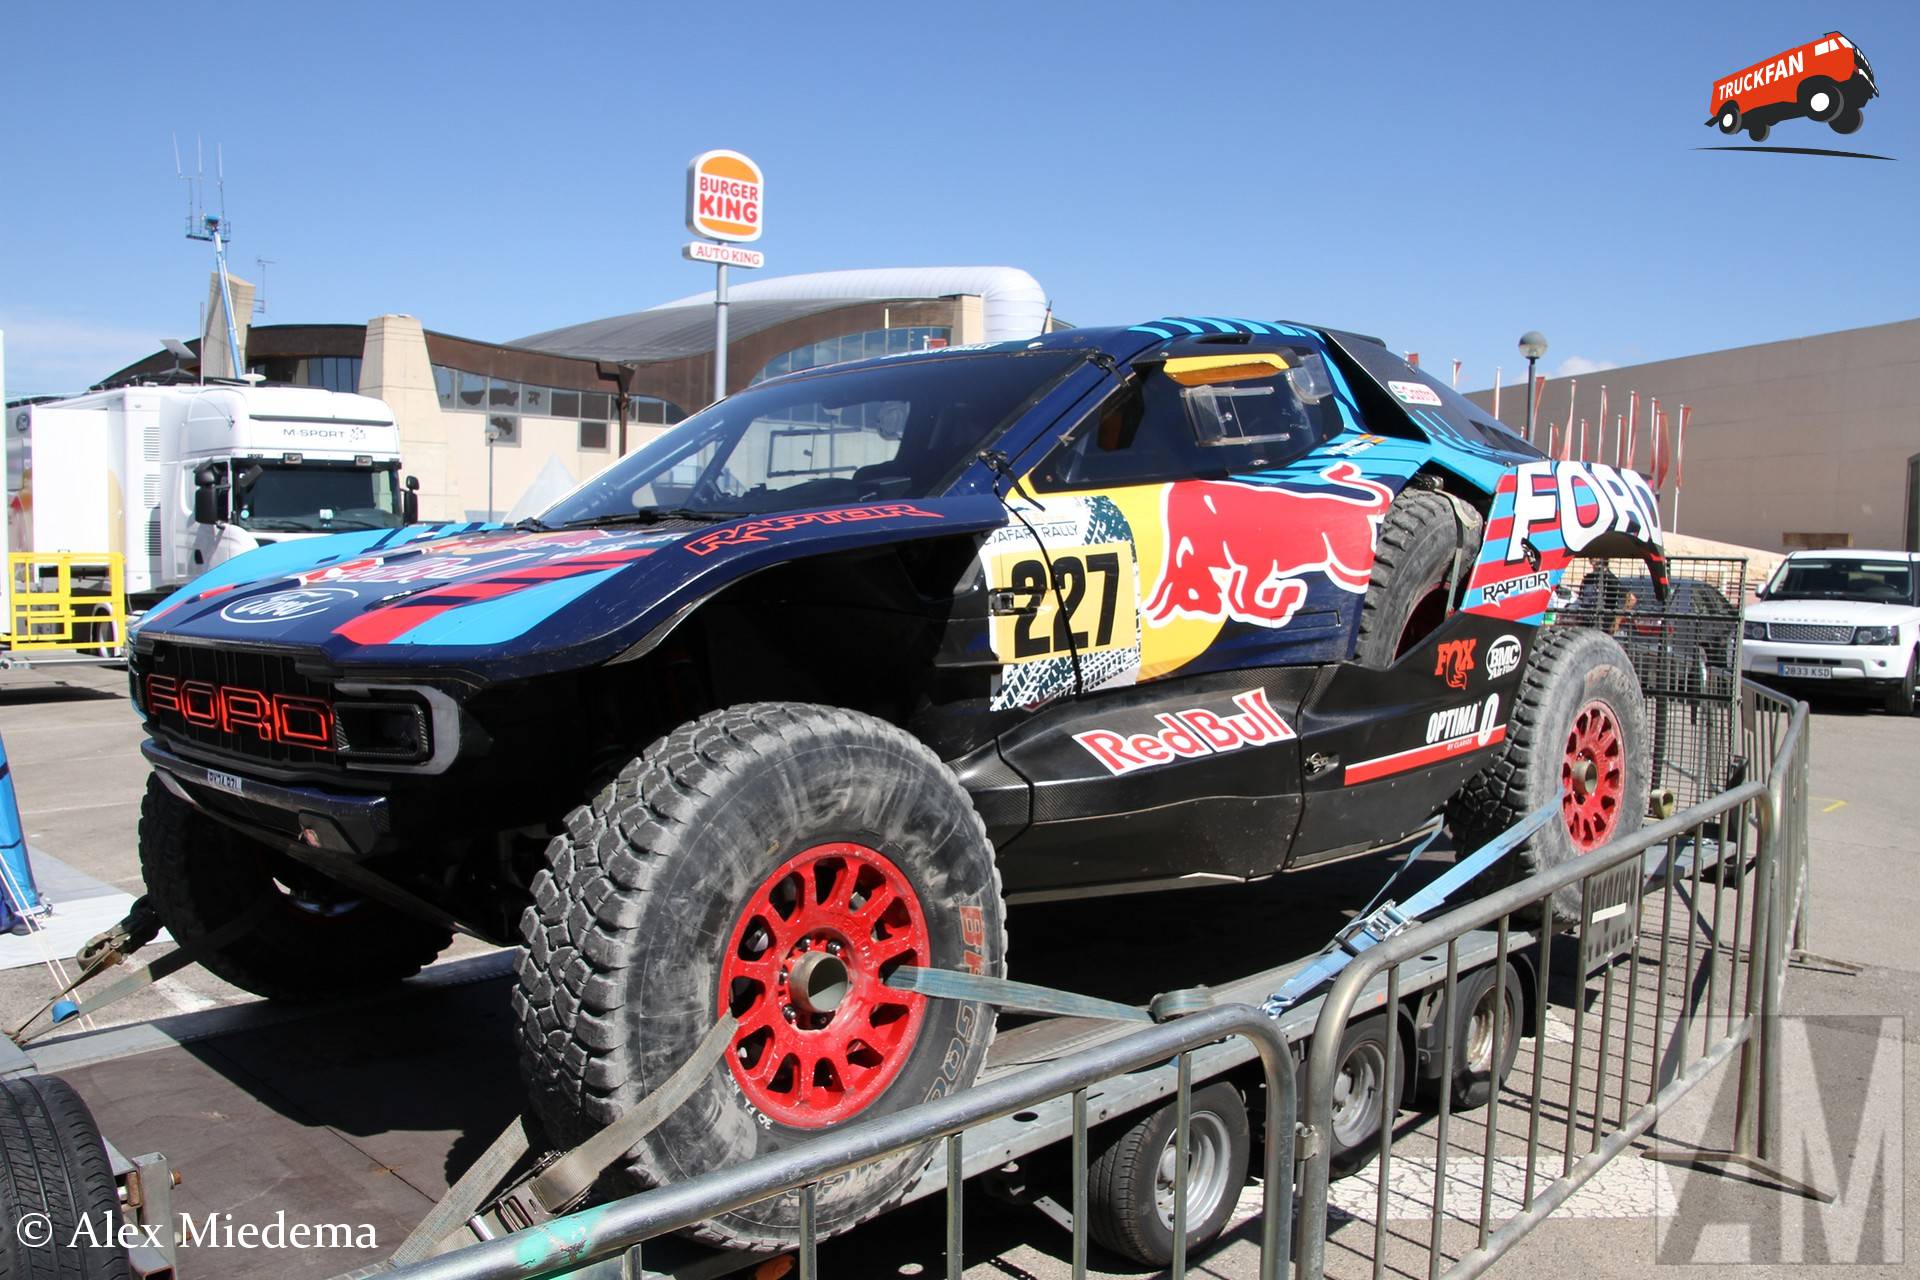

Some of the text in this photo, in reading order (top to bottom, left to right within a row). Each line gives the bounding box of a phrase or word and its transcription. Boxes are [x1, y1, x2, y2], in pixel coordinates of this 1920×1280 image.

[699, 176, 759, 201] BURGER
[699, 193, 758, 224] KING
[696, 245, 760, 265] AUTO KING
[1505, 460, 1663, 561] FORD
[684, 504, 945, 556] RAPTOR
[985, 524, 1078, 546] AFAR RALLY
[1482, 572, 1552, 603] RAPTOR
[1011, 552, 1119, 659] 227
[1434, 639, 1477, 684] FOX
[1490, 644, 1519, 669] BMC
[1785, 665, 1809, 675] 2833
[148, 673, 336, 752] FORD
[1426, 704, 1479, 744] OPTIMA
